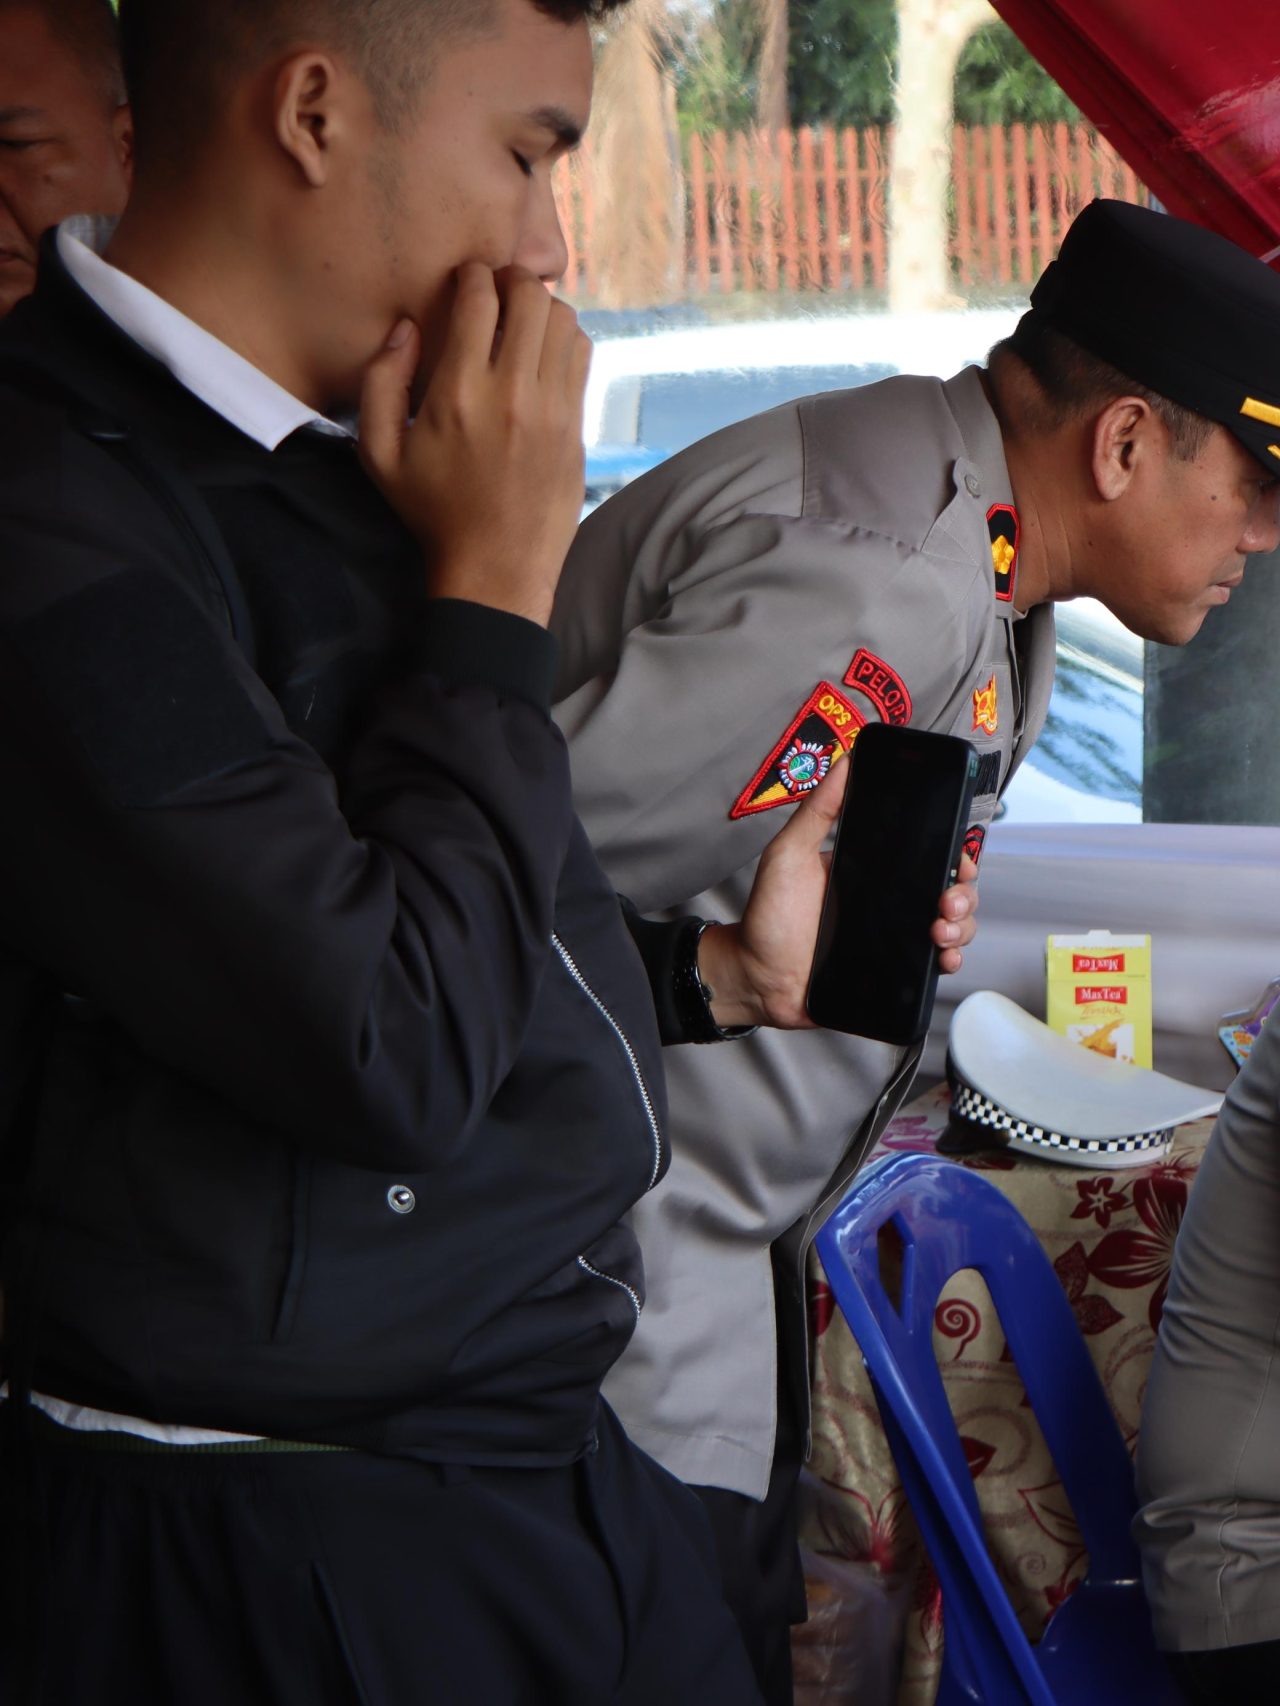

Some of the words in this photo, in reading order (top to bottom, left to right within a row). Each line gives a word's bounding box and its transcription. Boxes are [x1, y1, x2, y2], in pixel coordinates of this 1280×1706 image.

[857, 661, 906, 724] PELOP
[818, 695, 852, 727] OPS
[1081, 987, 1121, 1000] MaxTea
